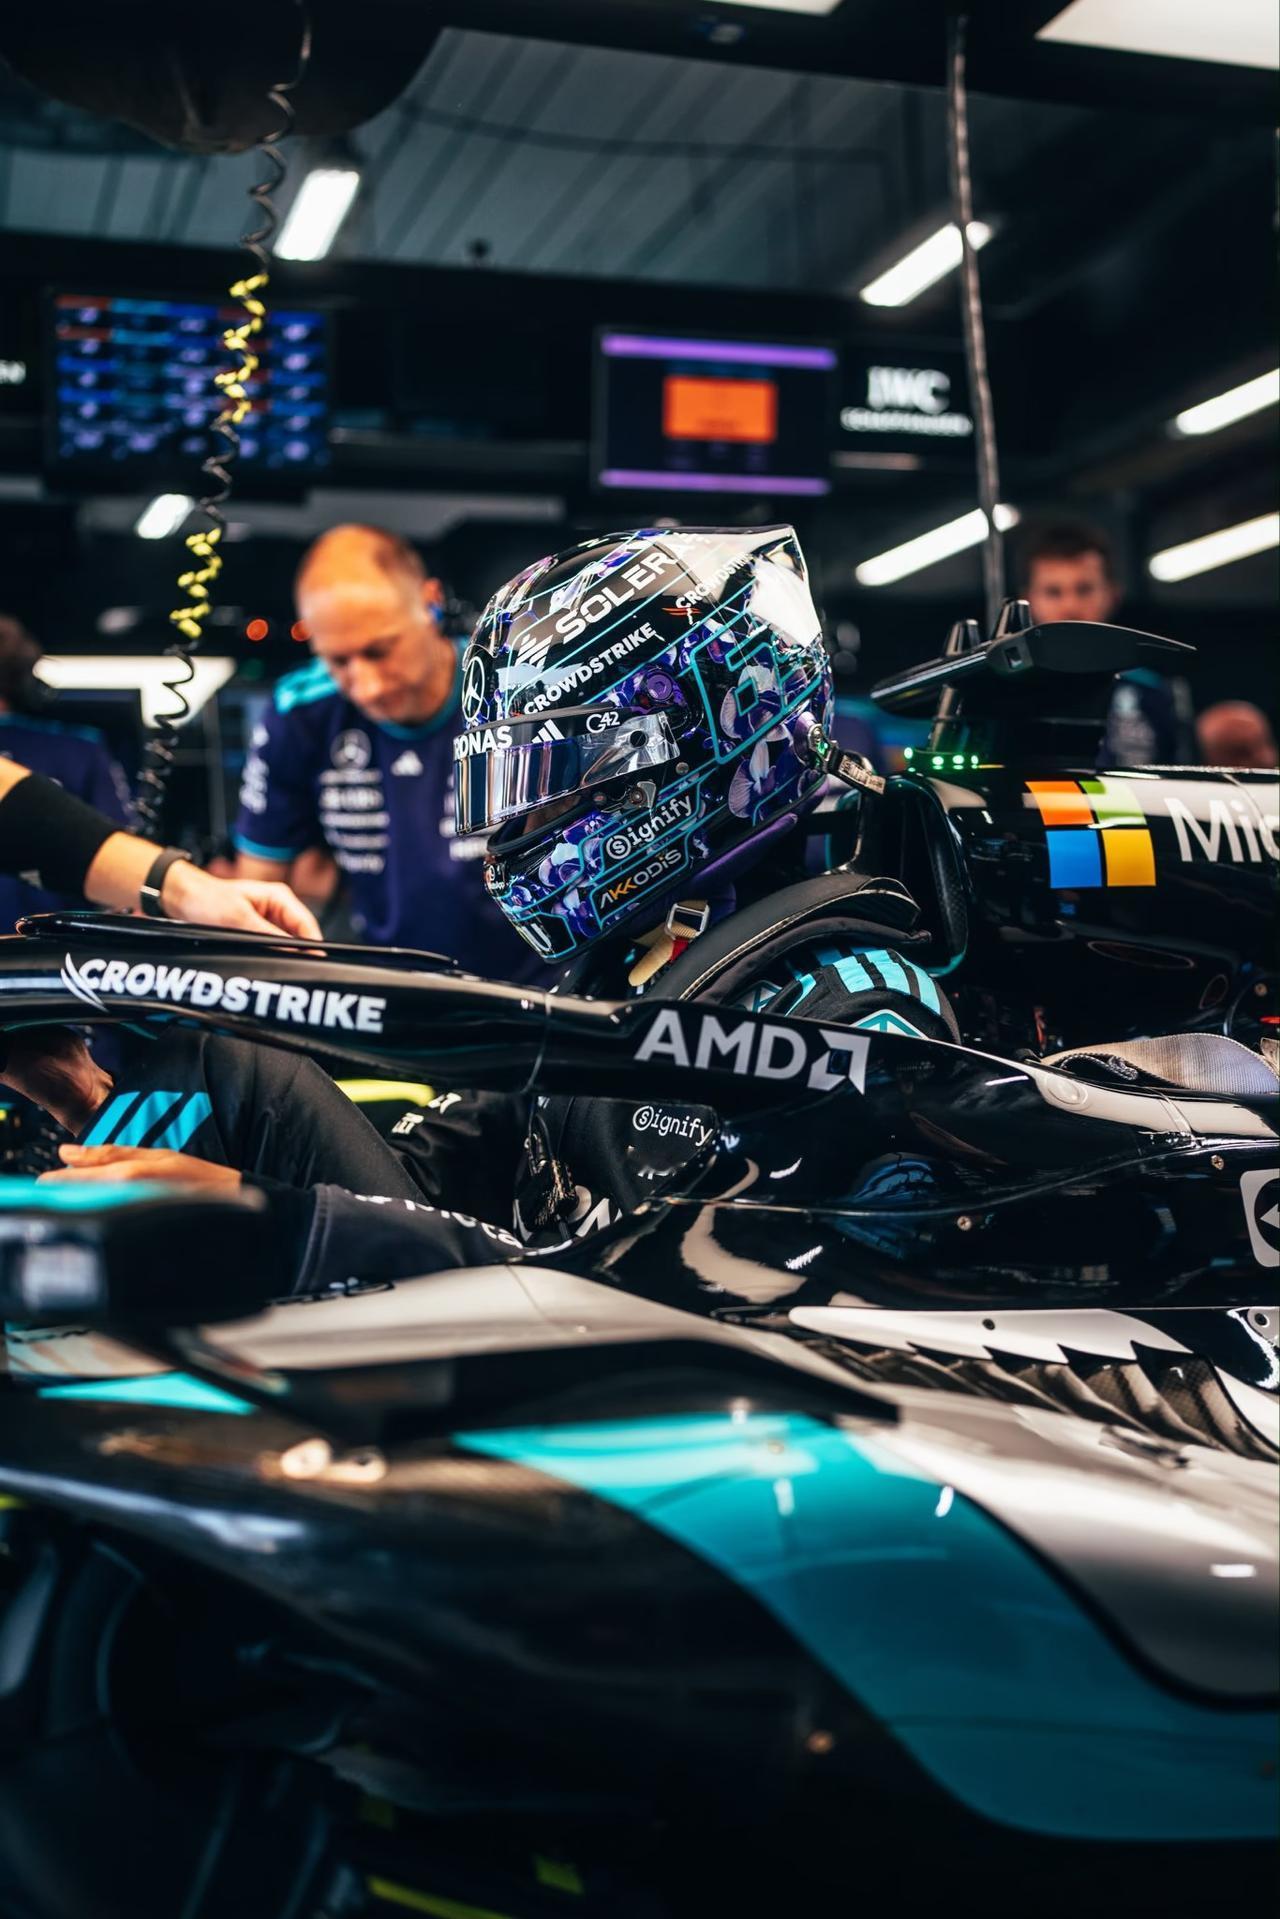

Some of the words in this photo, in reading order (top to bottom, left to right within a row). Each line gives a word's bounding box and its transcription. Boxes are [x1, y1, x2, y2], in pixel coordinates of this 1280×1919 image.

[523, 621, 657, 715] CROWDSTRIKE
[586, 711, 620, 734] G42
[606, 795, 692, 859] Signify
[78, 958, 387, 1034] CROWDSTRIKE
[633, 1008, 807, 1080] AMD
[632, 1105, 713, 1147] Signify
